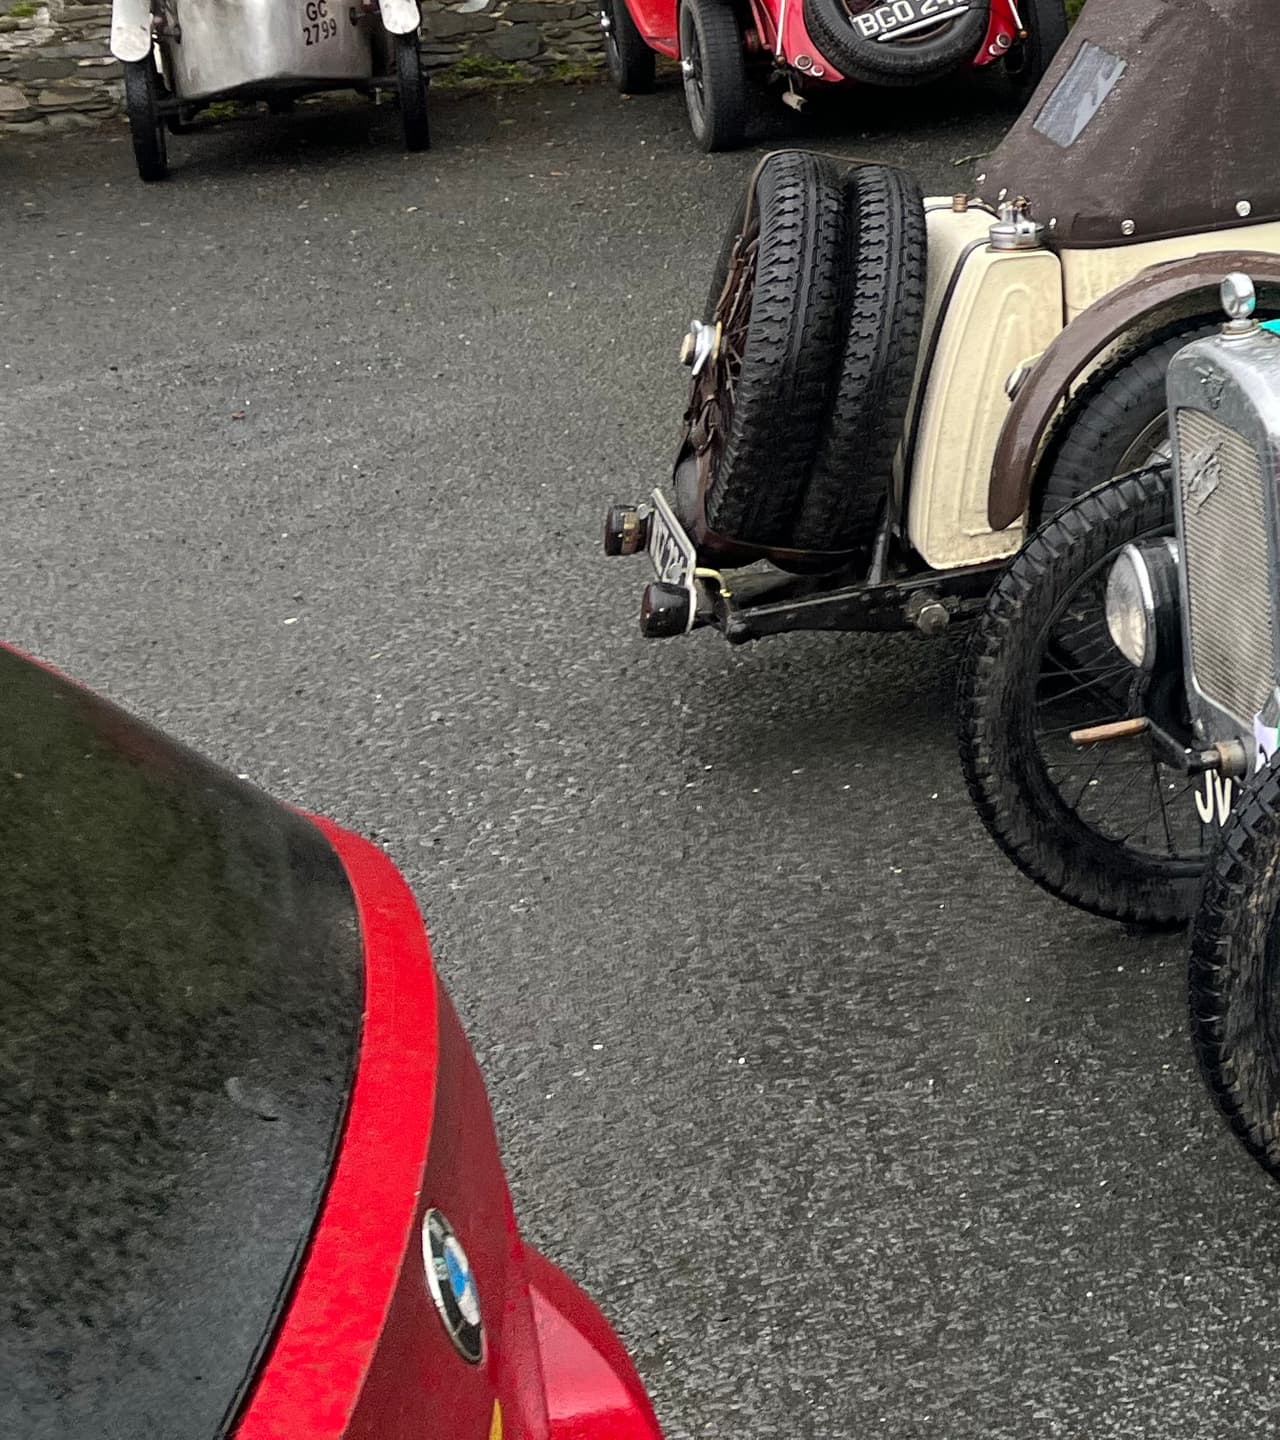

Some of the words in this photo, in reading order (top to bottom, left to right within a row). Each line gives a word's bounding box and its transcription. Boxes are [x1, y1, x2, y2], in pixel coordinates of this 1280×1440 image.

[306, 0, 328, 22] GC
[853, 0, 915, 36] BGO
[303, 18, 337, 46] 2799
